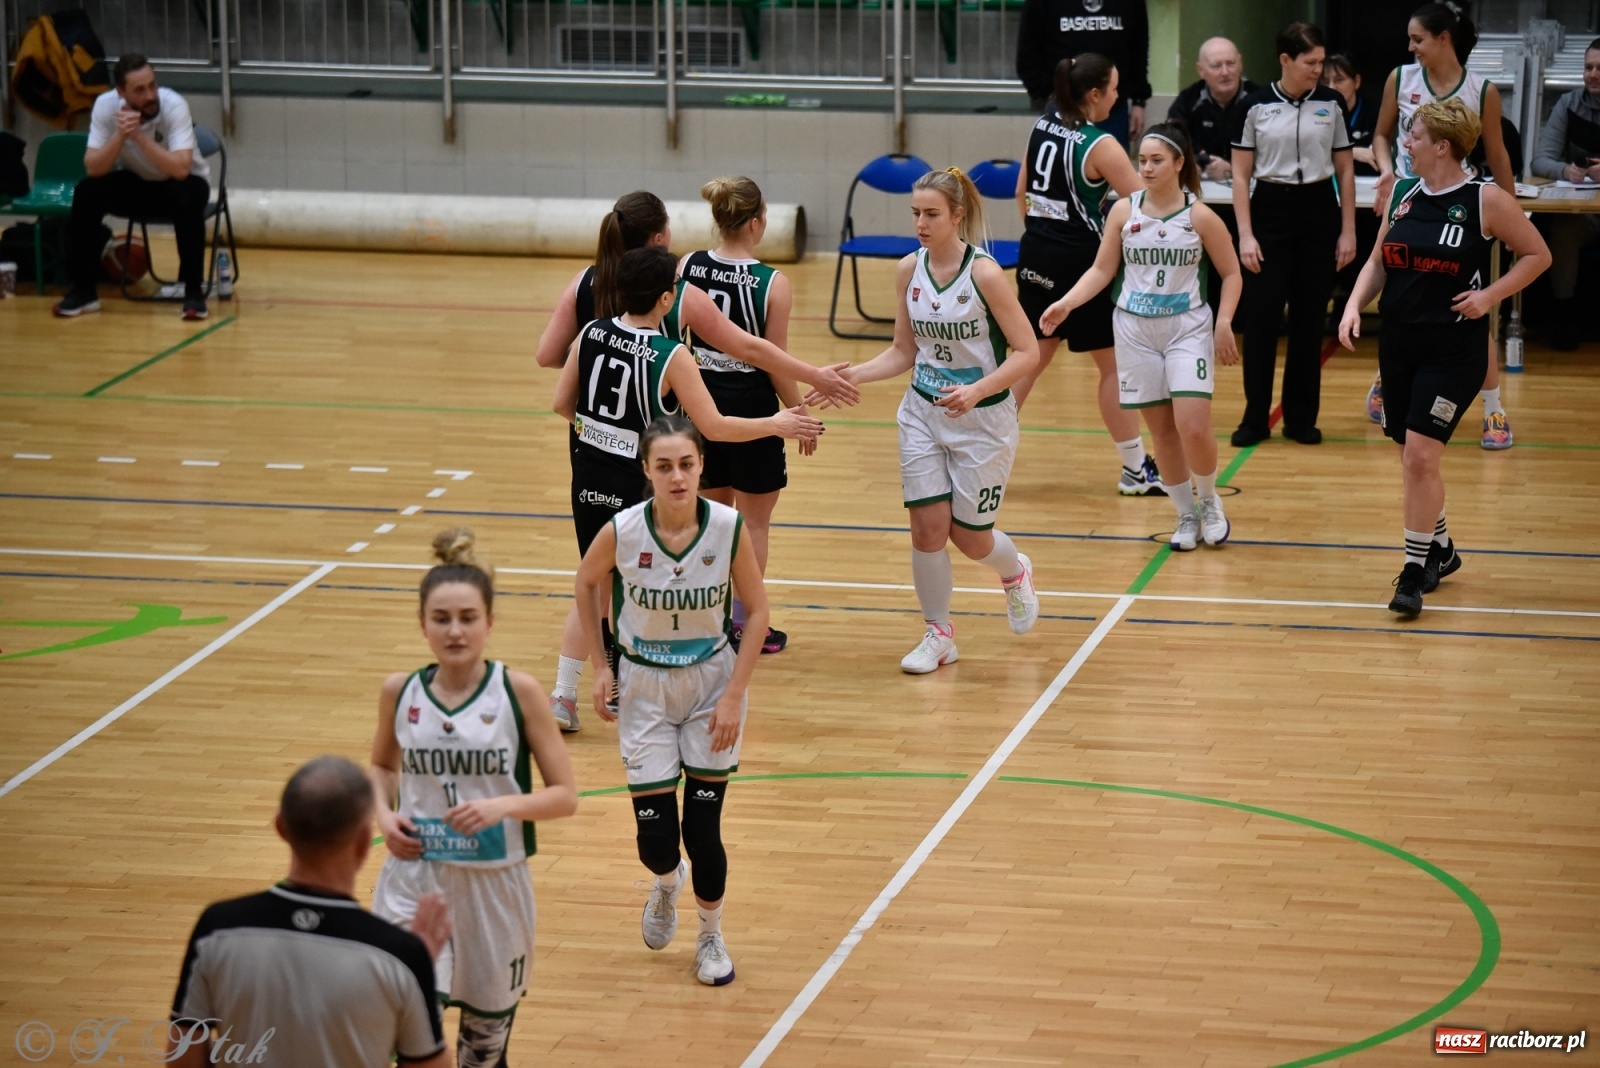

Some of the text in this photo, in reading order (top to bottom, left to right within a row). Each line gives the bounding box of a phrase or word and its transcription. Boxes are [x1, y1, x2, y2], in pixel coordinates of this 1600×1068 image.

[1060, 16, 1123, 32] BASKETBALL
[1032, 140, 1058, 192] 9
[1438, 223, 1464, 248] 10
[1125, 246, 1199, 267] KATOWICE
[1413, 256, 1460, 274] KAMAN
[689, 265, 760, 288] RKK RACIBÓRZ
[1027, 270, 1055, 288] Clavis
[1156, 269, 1166, 288] 8
[1129, 303, 1174, 315] ELEKTRO
[1132, 295, 1154, 306] max
[588, 327, 659, 362] RKK RACIBÓRZ
[934, 343, 953, 362] 25
[1196, 357, 1207, 380] 8
[588, 353, 632, 420] 13
[583, 428, 635, 452] WAGTECH
[587, 491, 623, 507] Clavis
[977, 485, 1002, 514] 25
[627, 582, 727, 611] KATOWICE
[671, 613, 680, 631] 1
[638, 641, 671, 654] max
[443, 782, 458, 808] 11
[510, 954, 526, 991] 11
